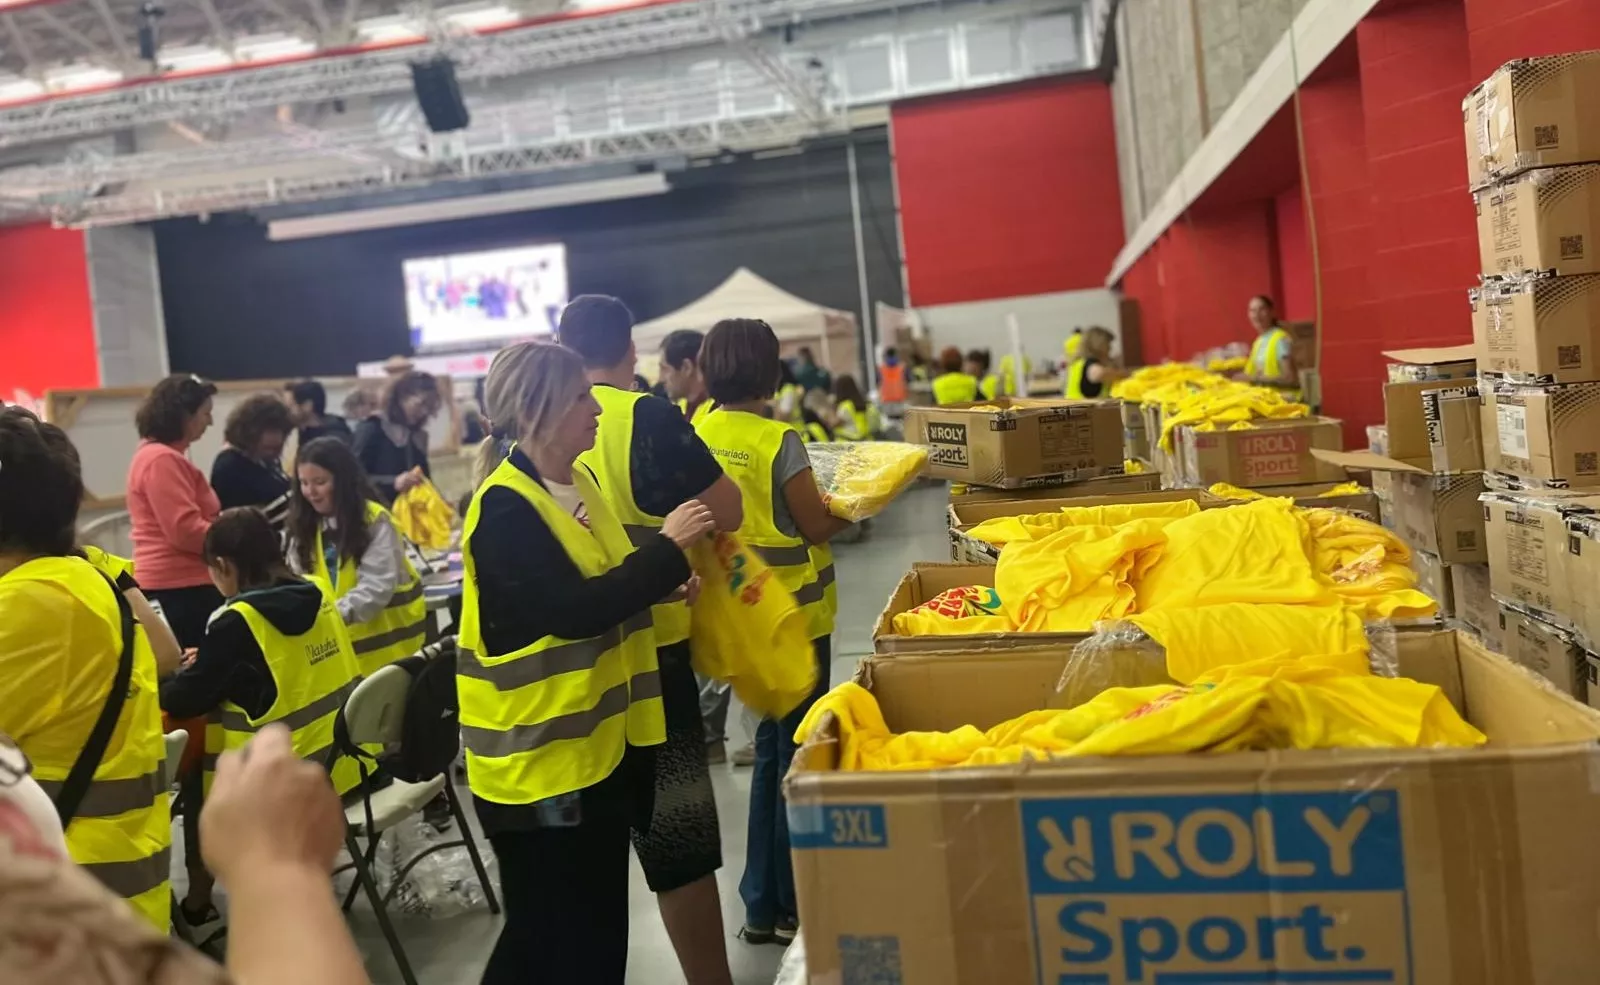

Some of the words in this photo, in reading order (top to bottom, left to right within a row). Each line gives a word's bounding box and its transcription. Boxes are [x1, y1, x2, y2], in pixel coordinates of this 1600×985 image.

[937, 426, 964, 441] ROLY
[1252, 434, 1297, 453] ROLY
[830, 808, 882, 844] 3XL
[1109, 805, 1371, 880] ROLY
